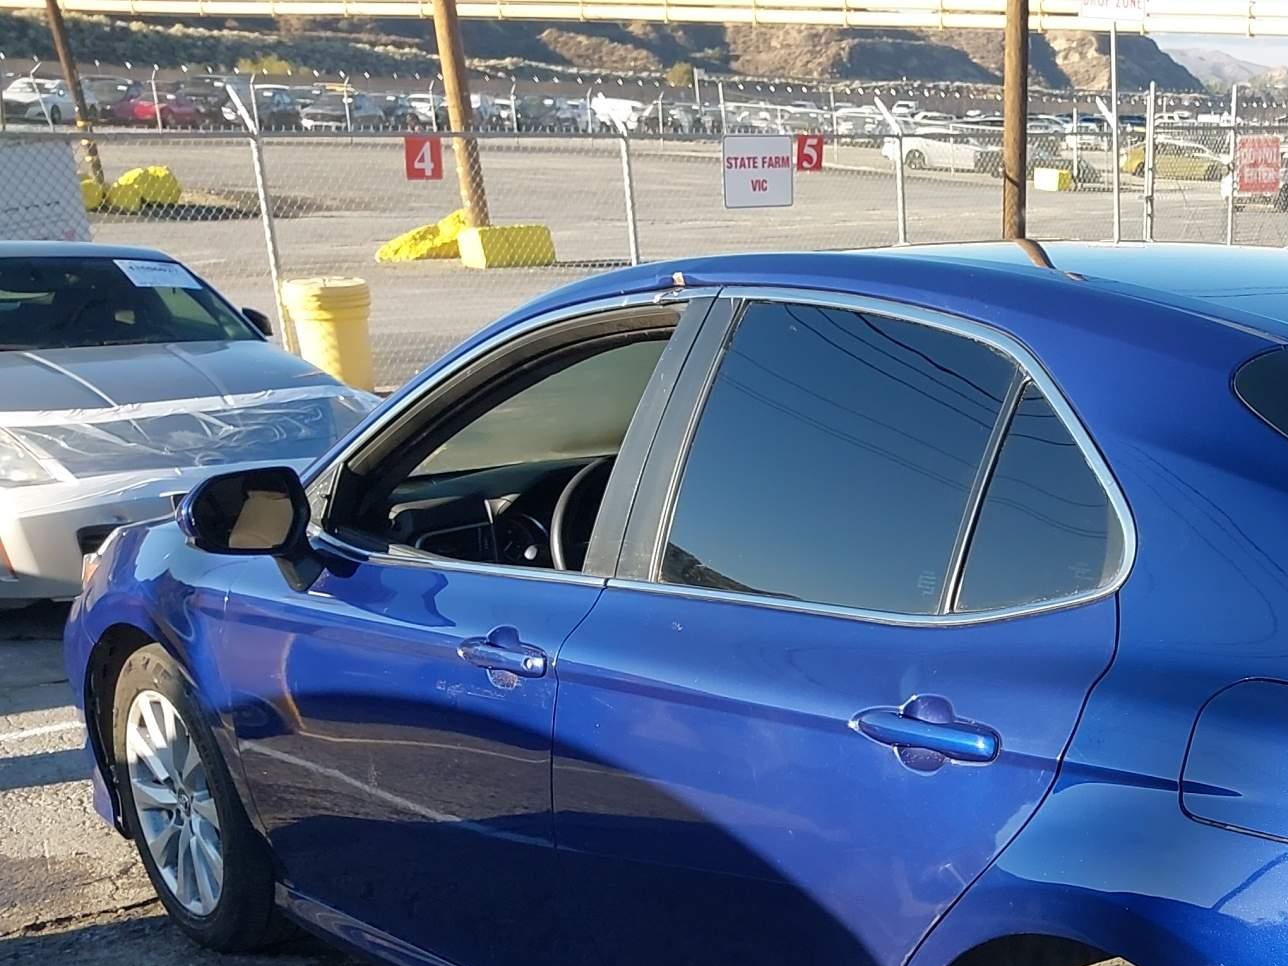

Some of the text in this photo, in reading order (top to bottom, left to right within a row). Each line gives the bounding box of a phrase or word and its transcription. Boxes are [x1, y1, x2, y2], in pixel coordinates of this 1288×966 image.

[414, 140, 434, 176] 4
[726, 155, 790, 169] STATE FARM
[802, 138, 818, 168] 5
[751, 179, 768, 192] VIC
